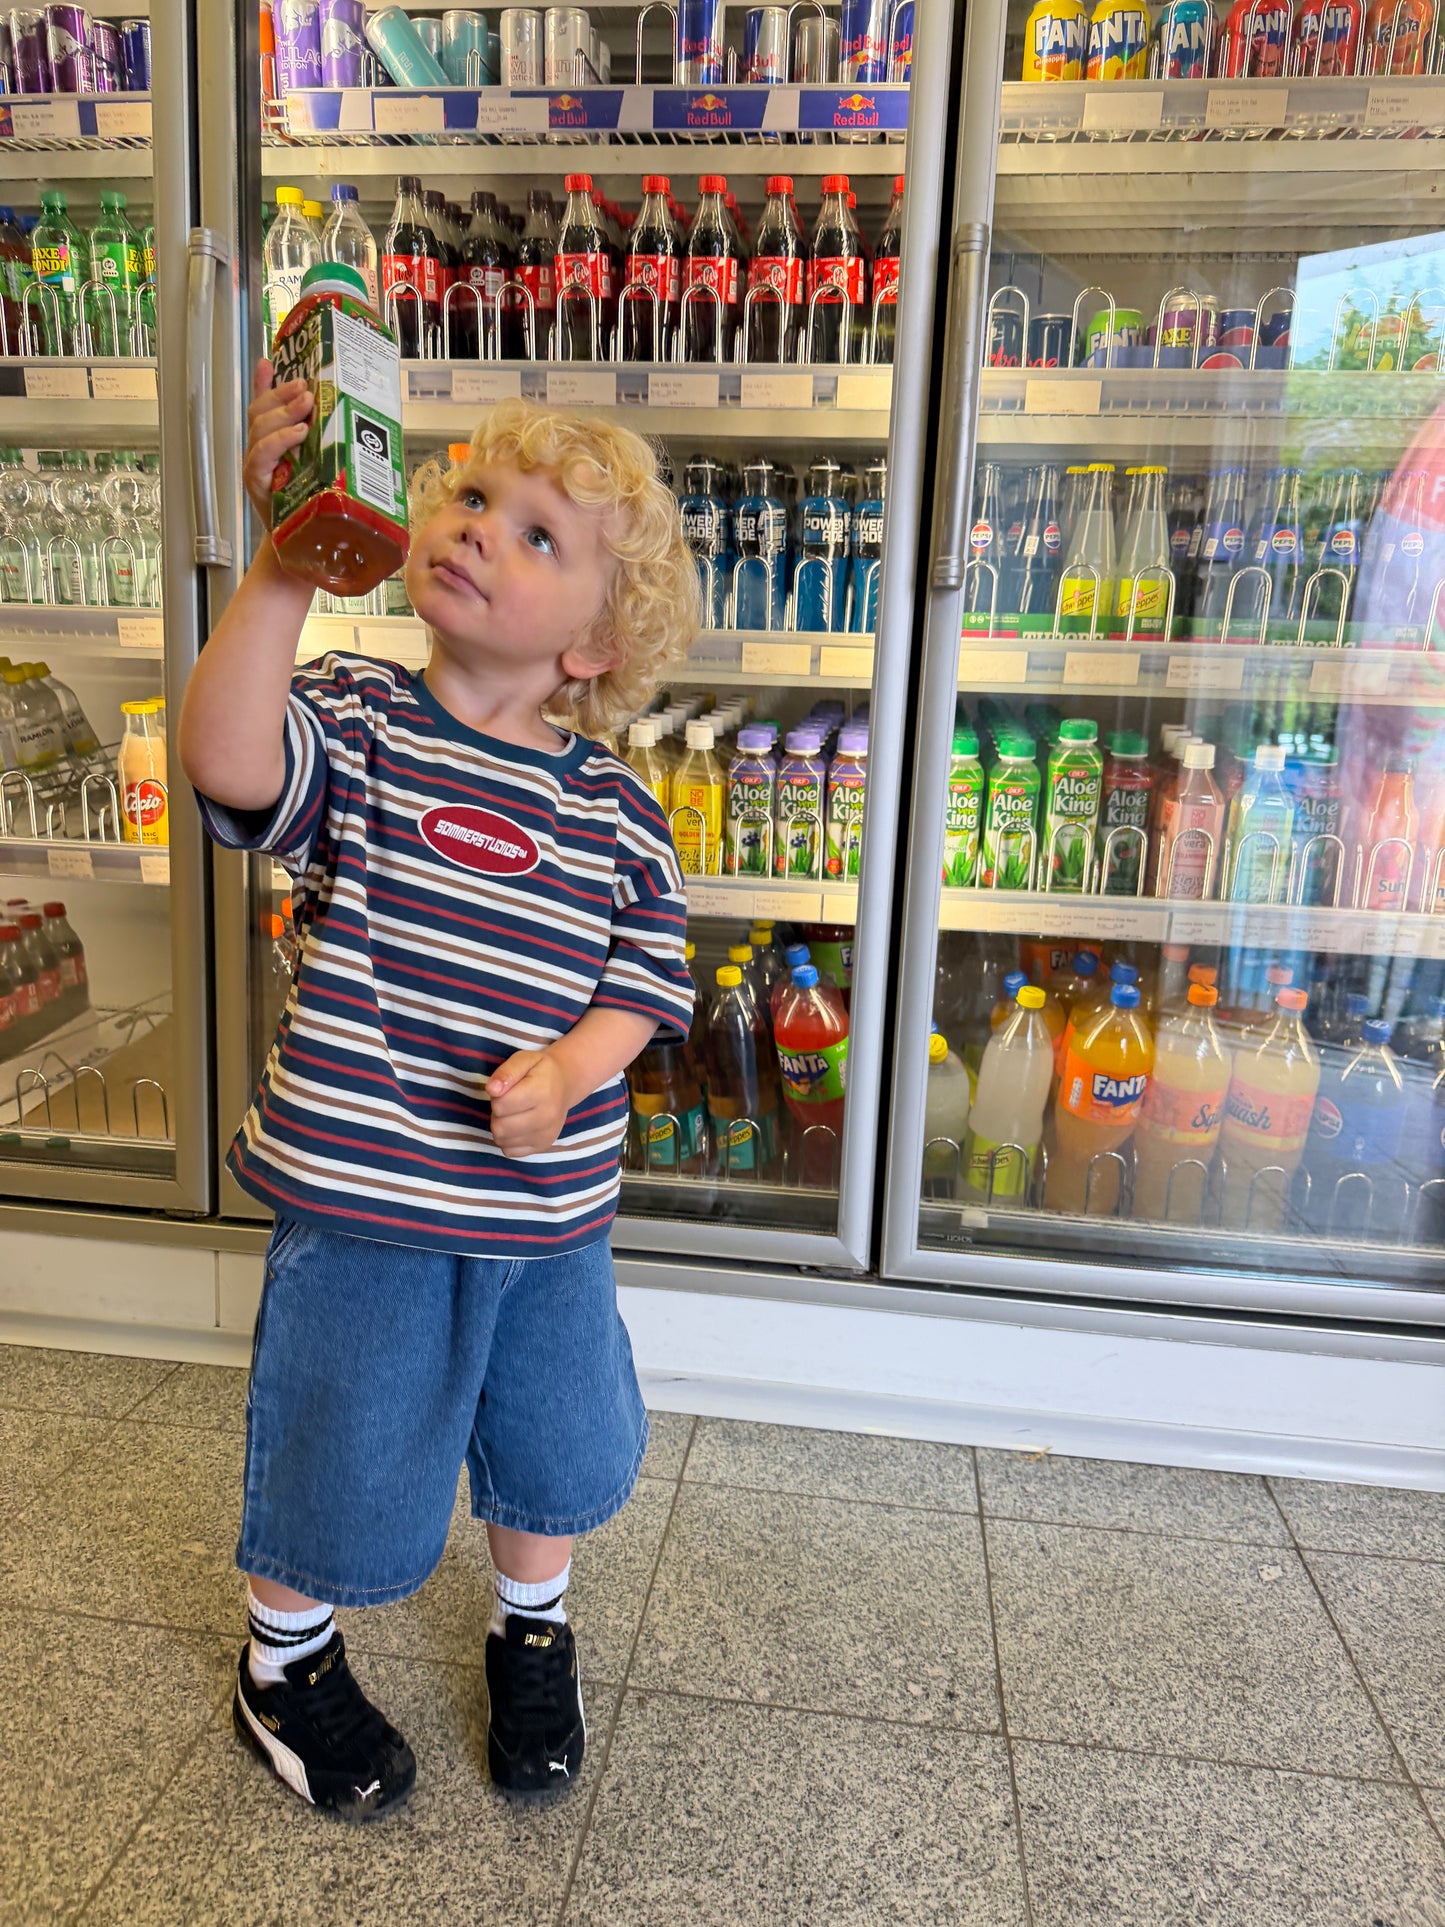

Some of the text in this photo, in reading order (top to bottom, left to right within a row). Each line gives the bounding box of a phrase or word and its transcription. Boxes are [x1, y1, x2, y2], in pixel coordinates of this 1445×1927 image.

[1243, 10, 1288, 35] FANT
[1036, 13, 1090, 52] FAN
[1088, 11, 1147, 55] ANTA
[863, 34, 886, 56] Bul
[567, 111, 588, 126] Bull
[687, 112, 732, 126] Red Bull
[833, 112, 879, 126] Red Bull
[1161, 327, 1191, 346] AXE
[804, 517, 844, 530] POWER
[853, 518, 883, 531] OWER
[688, 527, 713, 538] ADE
[1273, 537, 1295, 545] PEPSI
[730, 784, 771, 801] Aloe
[780, 785, 818, 802] Aloe
[1055, 777, 1097, 795] Aloe
[124, 791, 162, 813] Cocio
[993, 794, 1033, 811] Aloe
[1055, 795, 1096, 815] King
[1107, 790, 1148, 807] Aloe
[1300, 795, 1339, 815] Aloe
[1107, 807, 1146, 826] King
[433, 819, 520, 859] SOMMERSTUDIOS
